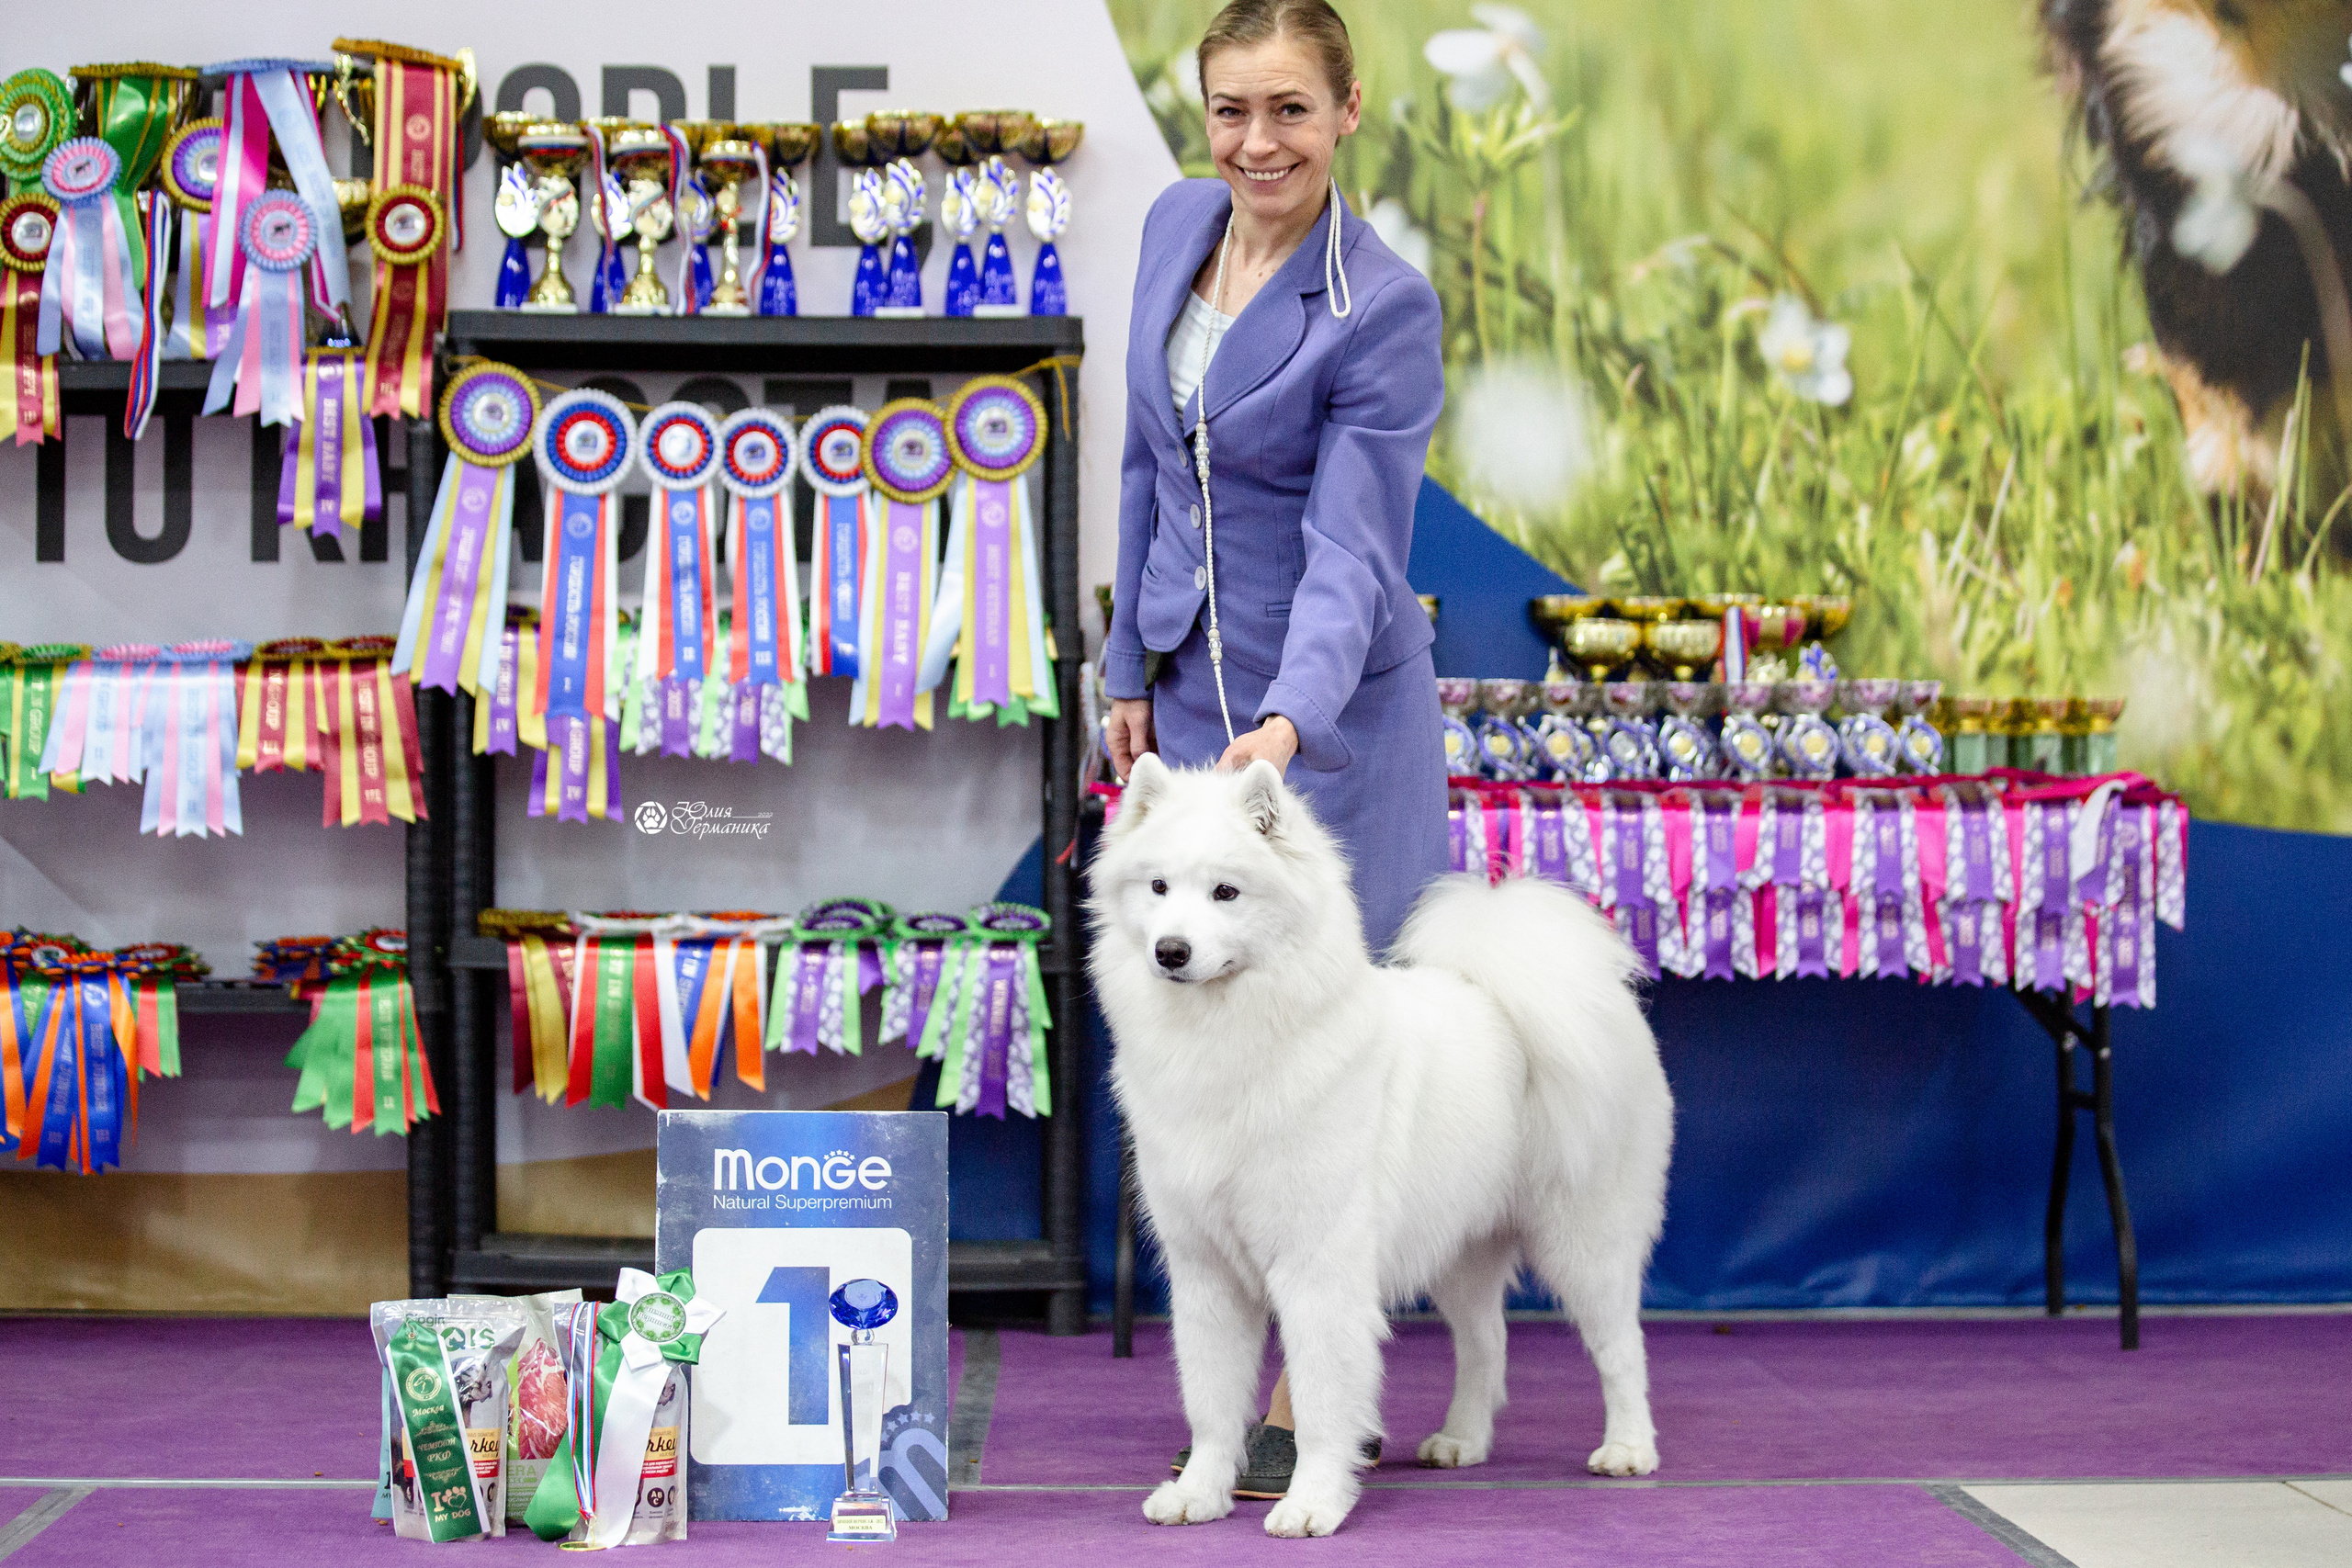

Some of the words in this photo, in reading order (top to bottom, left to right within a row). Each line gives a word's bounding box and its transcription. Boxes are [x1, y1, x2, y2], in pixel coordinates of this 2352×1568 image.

[713, 1194, 770, 1210] Natural
[775, 1194, 892, 1212] Superpremium
[754, 1266, 830, 1426] 1
[412, 1404, 445, 1417] Москва
[430, 1491, 445, 1513] I
[435, 1513, 448, 1523] MY
[451, 1508, 471, 1519] DOG
